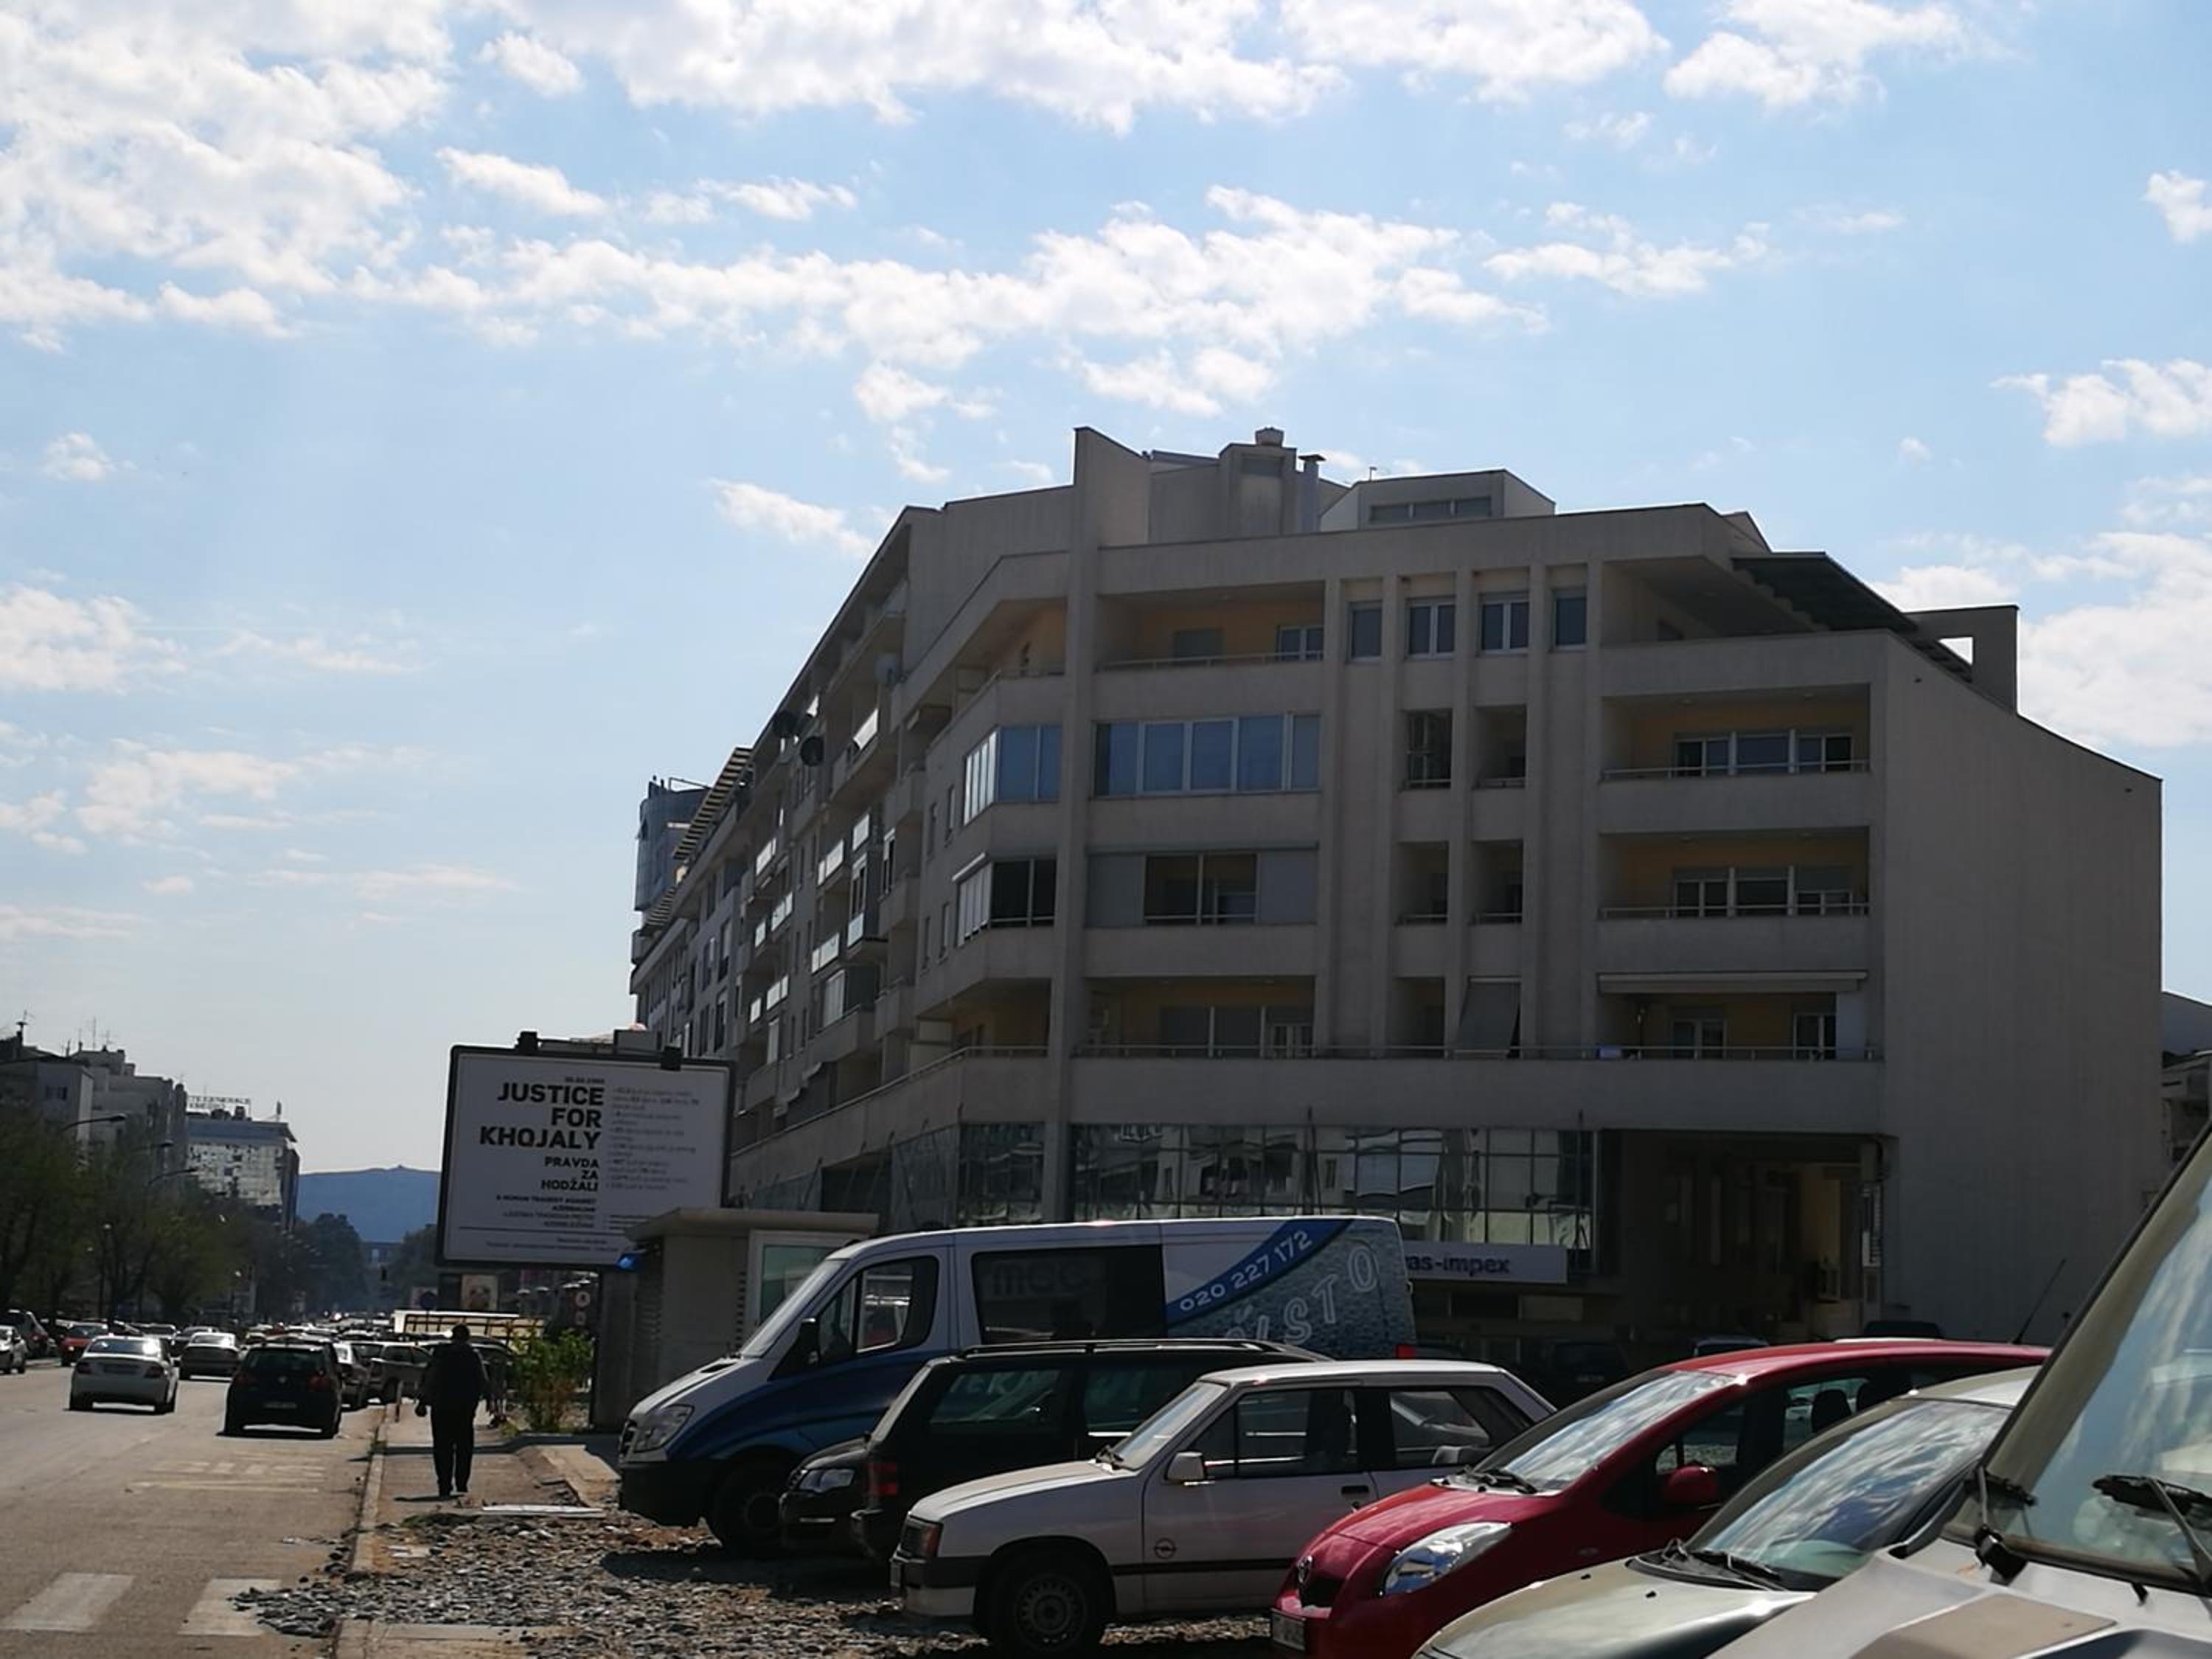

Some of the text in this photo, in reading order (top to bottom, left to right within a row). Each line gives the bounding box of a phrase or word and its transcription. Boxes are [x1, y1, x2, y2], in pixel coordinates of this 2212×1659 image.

[497, 1082, 604, 1106] JUSTICE
[551, 1107, 602, 1128] FOR
[544, 1156, 599, 1169] PRAVDA
[581, 1169, 599, 1180] ZA
[541, 1177, 598, 1192] HODŽALI
[1179, 1230, 1313, 1312] 020 227 172
